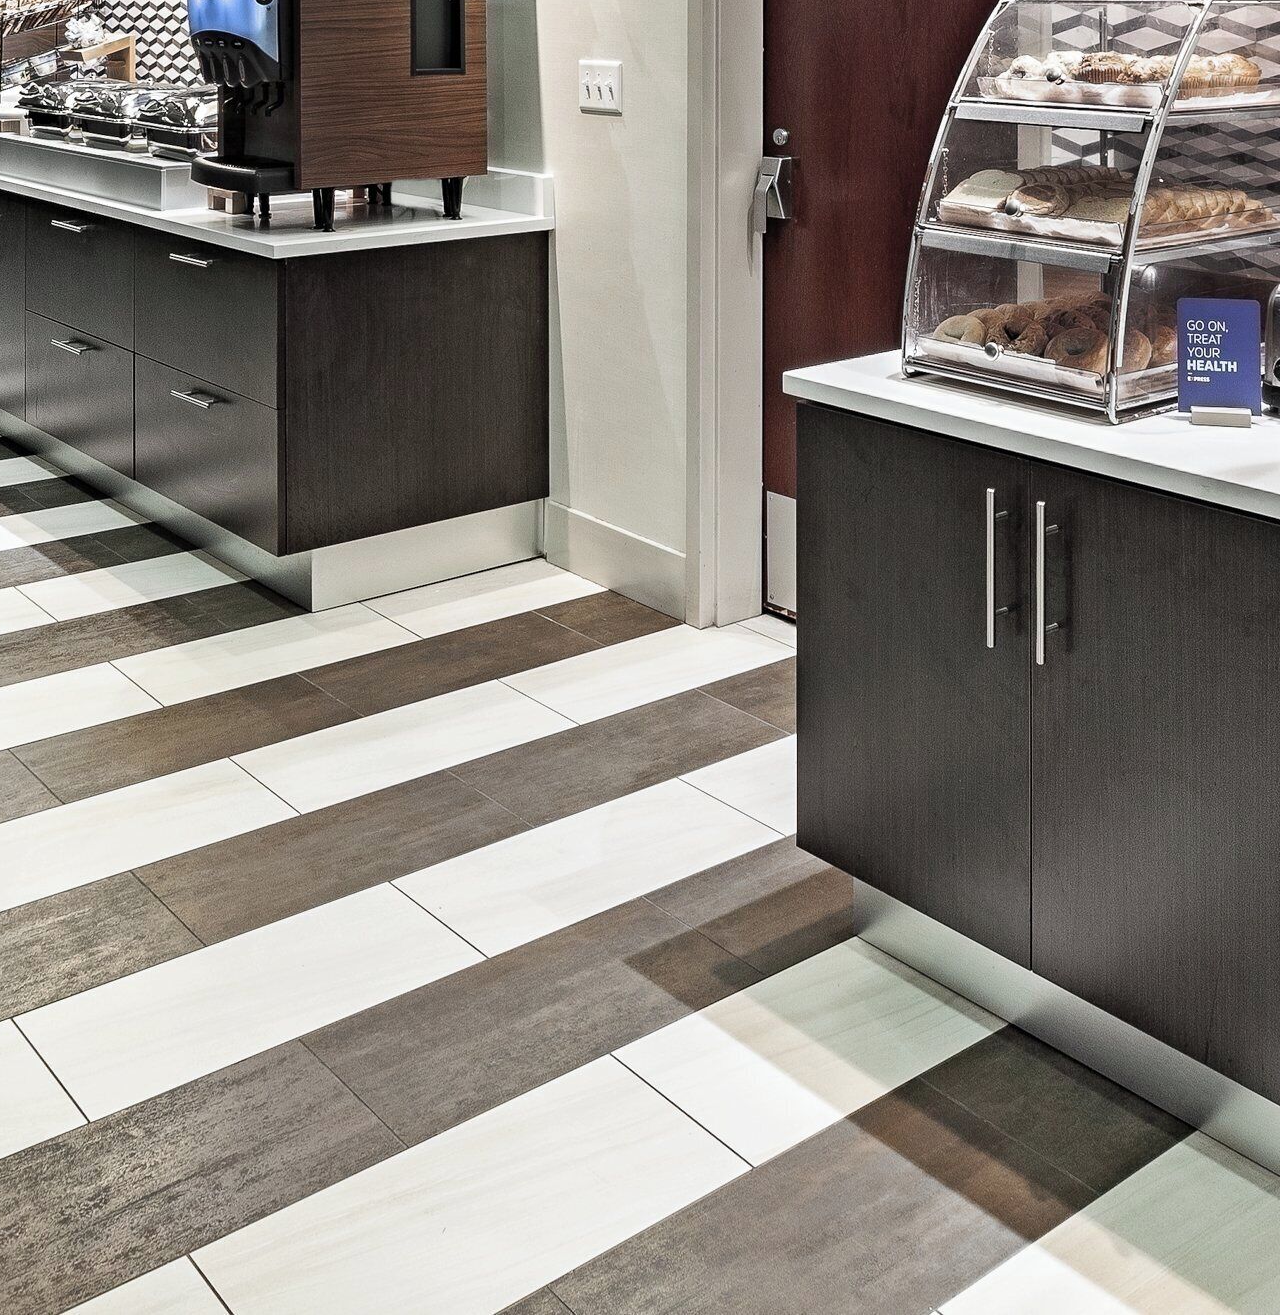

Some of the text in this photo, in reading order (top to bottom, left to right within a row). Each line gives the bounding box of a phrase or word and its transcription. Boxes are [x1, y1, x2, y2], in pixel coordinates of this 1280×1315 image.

[1186, 320, 1229, 333] GO ON,
[1187, 333, 1223, 345] TREAT
[1186, 346, 1221, 359] YOUR
[1186, 359, 1238, 373] HEALTH
